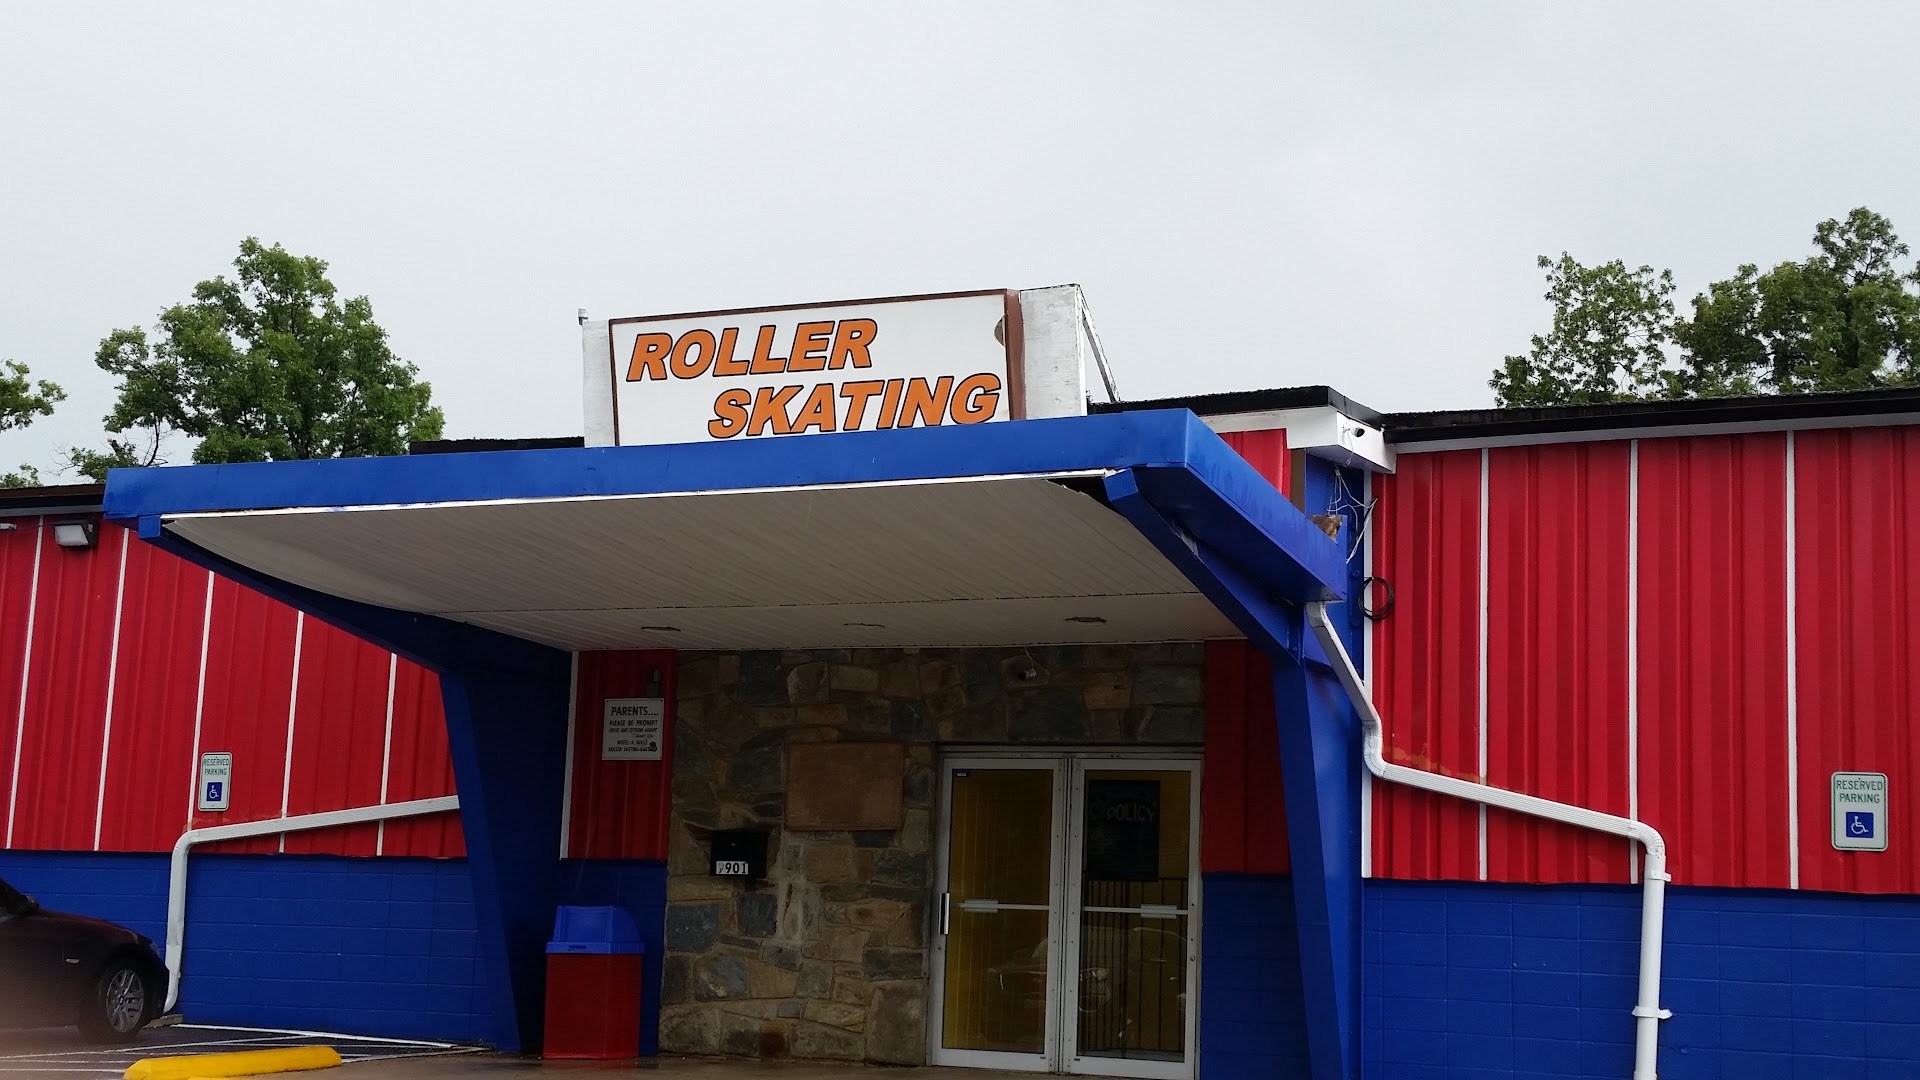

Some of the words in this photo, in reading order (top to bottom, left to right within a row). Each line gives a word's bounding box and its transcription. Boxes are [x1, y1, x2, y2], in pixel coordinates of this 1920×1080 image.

[626, 318, 877, 382] ROLLER
[708, 372, 1002, 438] SKATING
[609, 719, 626, 727] PLEASE
[628, 719, 634, 727] BE
[636, 719, 658, 727] PROMPT
[203, 758, 229, 766] RESERVED
[204, 768, 227, 776] PARKING
[1836, 780, 1883, 791] RESERVED
[1839, 793, 1880, 804] PARKING
[1106, 802, 1154, 822] POLICY
